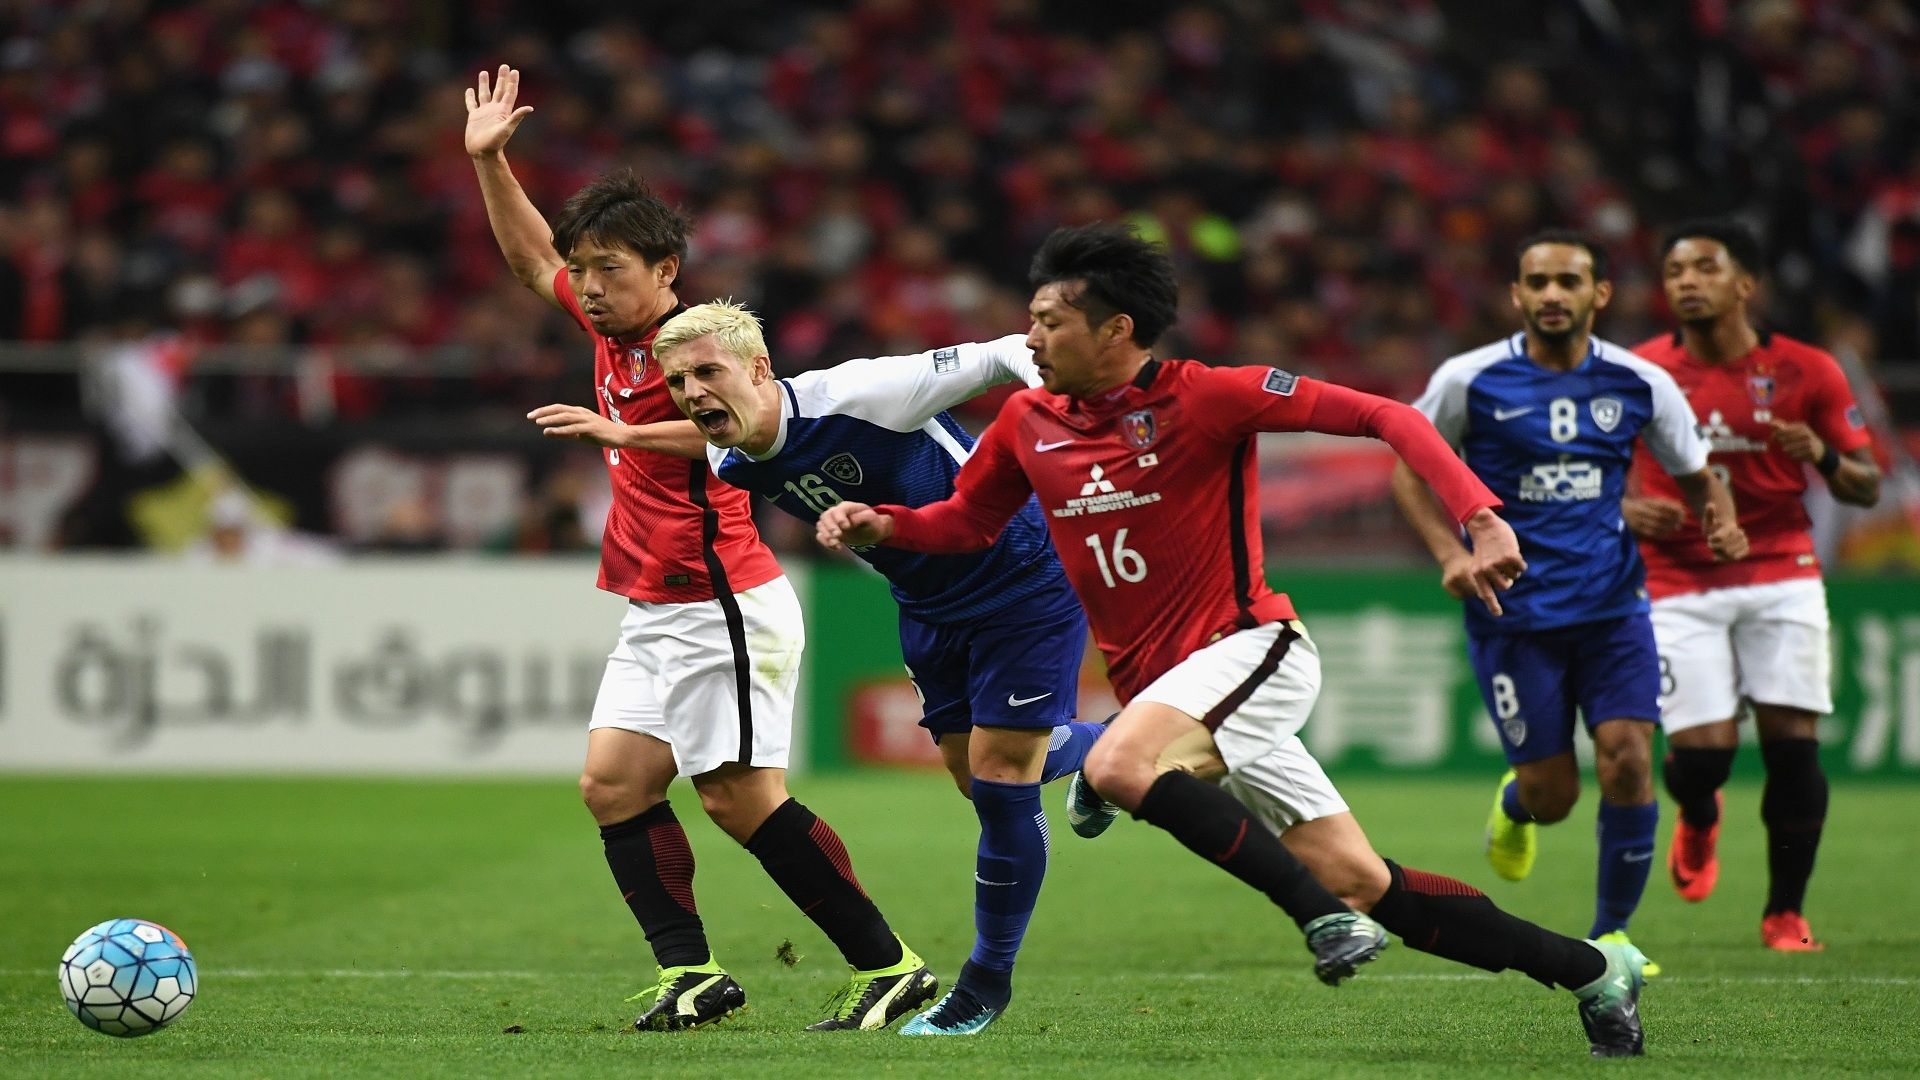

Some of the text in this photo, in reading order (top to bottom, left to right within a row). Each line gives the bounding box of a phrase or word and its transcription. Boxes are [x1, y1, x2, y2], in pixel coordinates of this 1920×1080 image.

[1549, 398, 1577, 442] 8
[784, 474, 843, 514] 16
[1066, 490, 1134, 508] MITSUBISHI
[1087, 492, 1162, 514] INDUSTRIES
[1085, 528, 1147, 588] 16
[1492, 673, 1519, 720] 8
